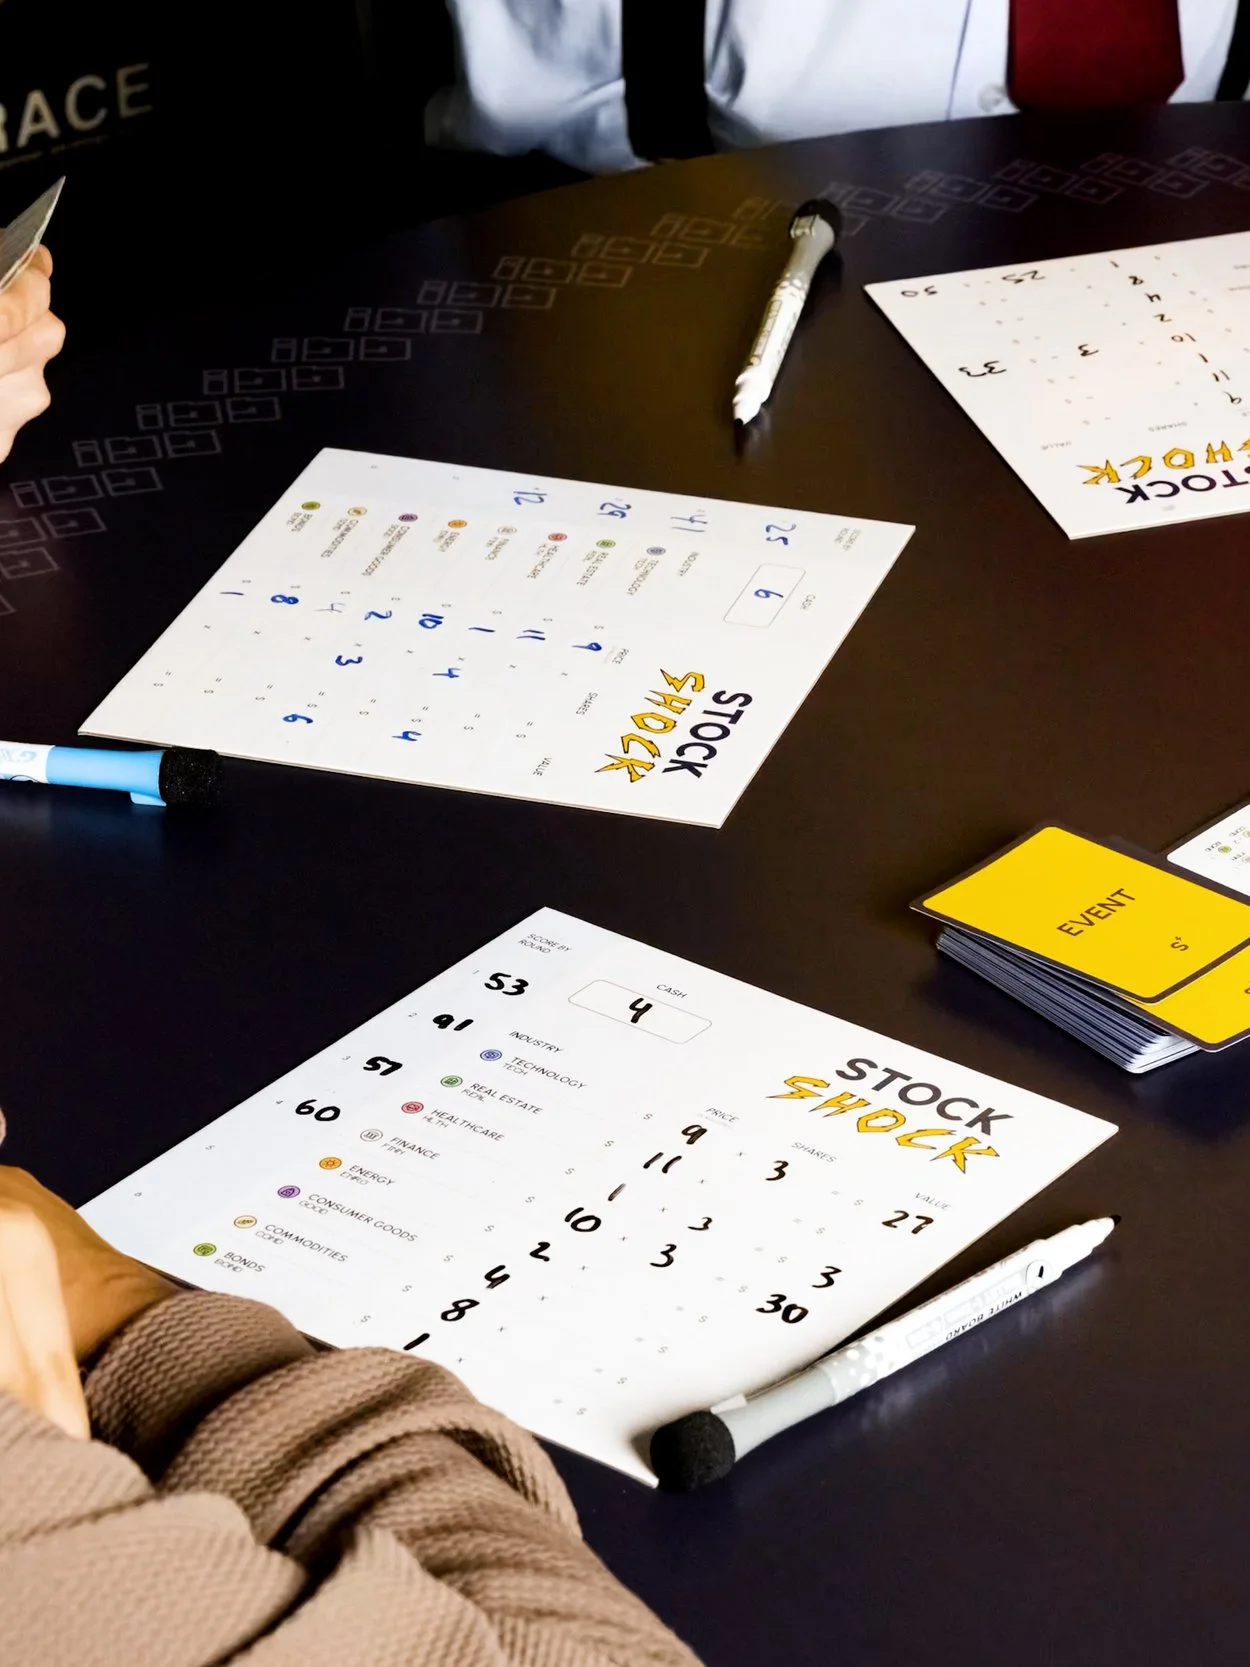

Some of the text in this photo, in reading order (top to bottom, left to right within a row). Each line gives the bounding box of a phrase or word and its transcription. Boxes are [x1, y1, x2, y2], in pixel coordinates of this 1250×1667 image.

[0, 62, 153, 150] ACE
[958, 360, 1007, 378] 33
[593, 668, 706, 783] SHOCK
[661, 689, 753, 779] STOCK
[1056, 887, 1136, 937] EVENT
[483, 971, 530, 996] 53
[655, 983, 688, 1000] CASH
[628, 997, 654, 1024] 4
[509, 1030, 564, 1054] INDUSTRY
[510, 1056, 589, 1089] TECHNOLOGY
[469, 1082, 544, 1115] REAL ESTATE
[834, 1056, 1015, 1138] STOCK
[294, 1099, 342, 1123] 60
[704, 1107, 740, 1124] PRICE
[430, 1108, 506, 1142] HEALTHCARE
[680, 1124, 708, 1146] 9
[765, 1074, 1001, 1174] SHOCK
[390, 1136, 441, 1160] FINANCE
[791, 1142, 838, 1164] SHARES
[348, 1164, 397, 1187] ENERGY
[764, 1160, 790, 1182] 3
[914, 1192, 952, 1211] VALUE
[307, 1193, 419, 1242] CONSUMER GOODS
[564, 1206, 602, 1233] 10
[687, 1216, 714, 1232] 3
[880, 1210, 934, 1235] 27
[264, 1223, 349, 1263] COMMODITIES
[529, 1241, 551, 1262] 2
[649, 1243, 678, 1268] 3
[223, 1251, 266, 1273] BONDS
[483, 1264, 512, 1289] 4
[810, 1265, 842, 1289] 3
[440, 1299, 481, 1322] 8
[754, 1293, 810, 1324] 30
